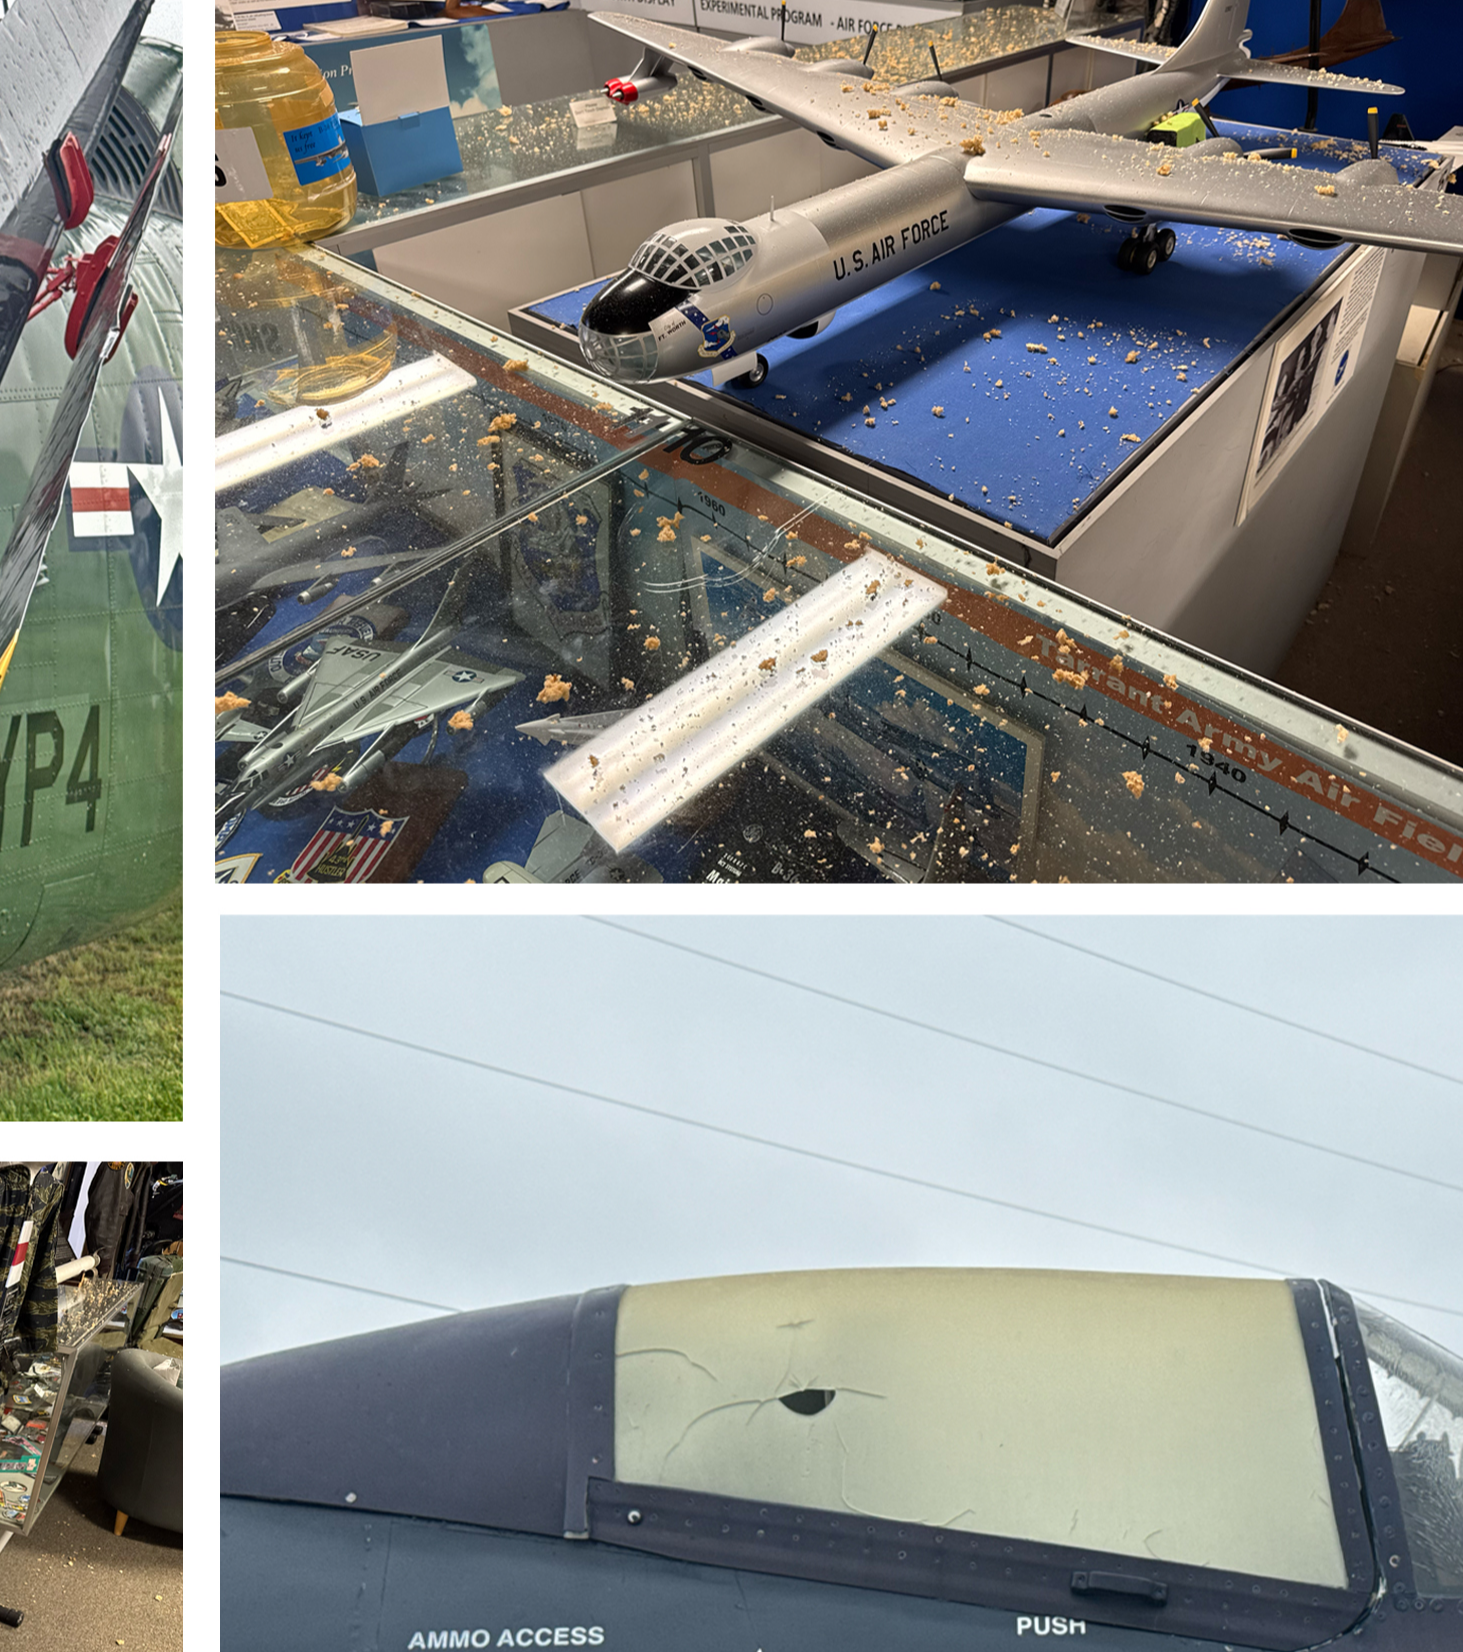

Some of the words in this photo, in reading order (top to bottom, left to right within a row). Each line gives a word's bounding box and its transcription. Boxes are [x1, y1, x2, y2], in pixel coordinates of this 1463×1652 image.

[701, 0, 770, 20] EXPERIMENTAL
[773, 6, 823, 28] PROGRAM
[836, 15, 855, 32] AIR
[833, 249, 869, 281] U.S.
[872, 235, 896, 265] AIR
[900, 210, 949, 250] FORCE
[667, 320, 687, 336] WORTH
[697, 491, 726, 517] 1960
[325, 644, 382, 663] USAF
[368, 684, 380, 702] AIR
[1036, 633, 1165, 715] Tarrant
[1176, 708, 1283, 772] Army
[1295, 769, 1361, 808] Air
[1373, 804, 1463, 863] Fiel
[1186, 743, 1247, 784] 1940
[316, 863, 346, 877] HUSTLER
[1016, 1616, 1087, 1636] PUSH
[408, 1628, 491, 1651] AMMO
[496, 1625, 605, 1648] ACCESS
